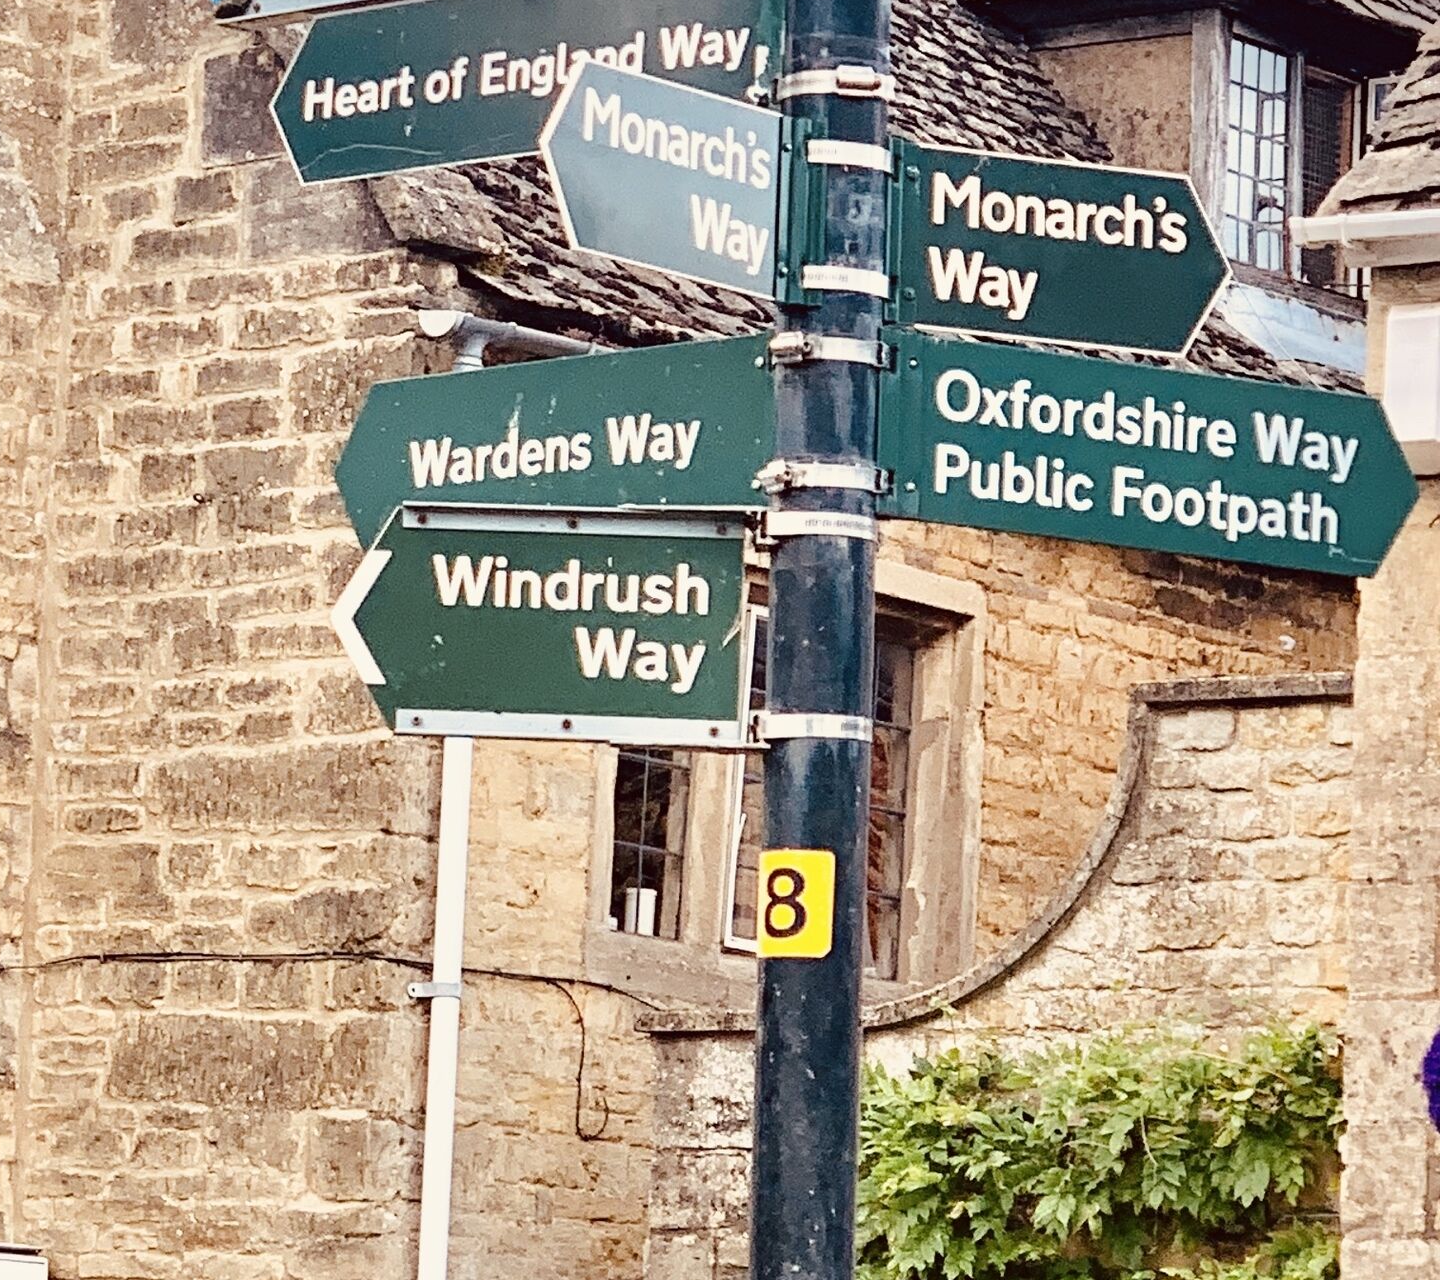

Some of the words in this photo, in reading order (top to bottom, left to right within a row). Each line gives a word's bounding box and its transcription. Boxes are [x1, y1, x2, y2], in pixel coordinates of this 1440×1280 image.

[303, 65, 415, 122] Heart
[425, 57, 468, 104] of
[660, 22, 751, 71] Way
[582, 87, 771, 190] Monarch's
[690, 194, 769, 276] Way
[931, 171, 1187, 254] Monarch's
[927, 246, 1038, 321] Way
[409, 424, 592, 489] Wardens
[606, 412, 701, 470] Way
[934, 369, 1238, 458] Oxfordshire
[1253, 411, 1359, 484] Way
[934, 443, 1094, 510] Public
[1112, 467, 1338, 546] Footpath
[432, 553, 710, 616] Windrush
[574, 626, 706, 694] Way
[764, 867, 807, 939] 8
